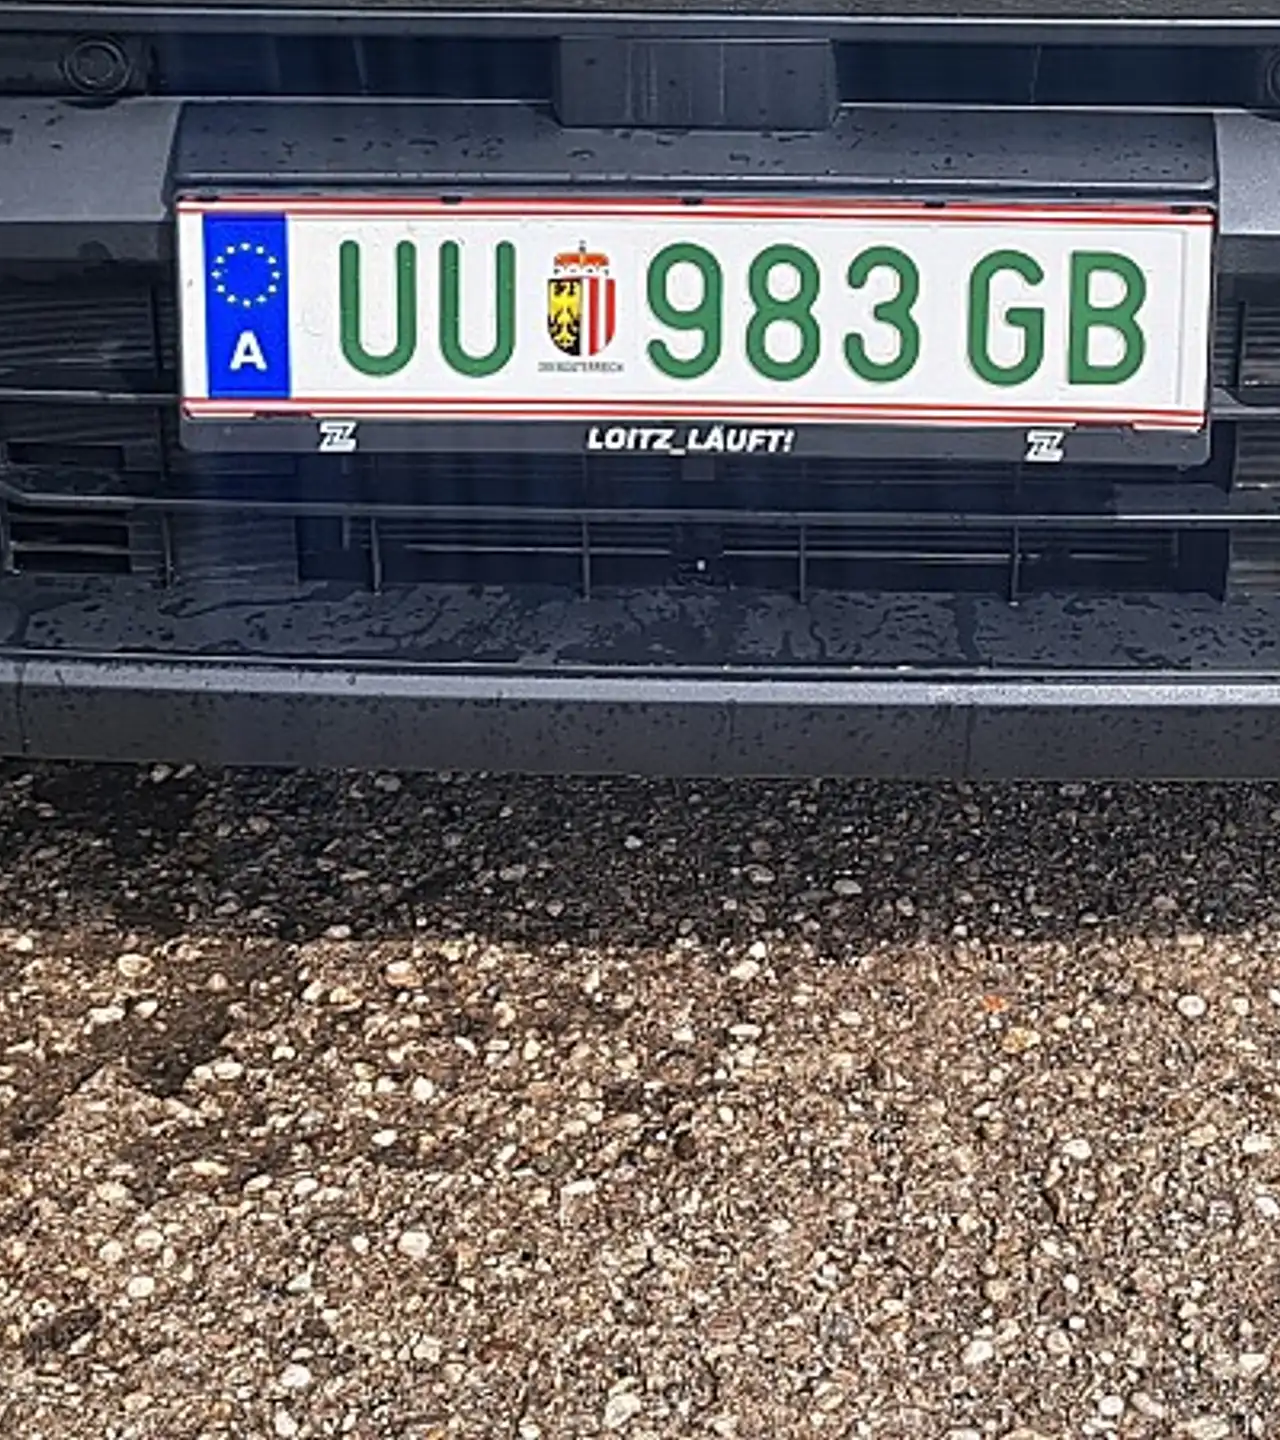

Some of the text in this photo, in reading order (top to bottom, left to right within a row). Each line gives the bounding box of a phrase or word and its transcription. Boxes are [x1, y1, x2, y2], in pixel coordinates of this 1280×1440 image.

[230, 329, 268, 371] A
[339, 239, 1148, 387] UU 983 GB
